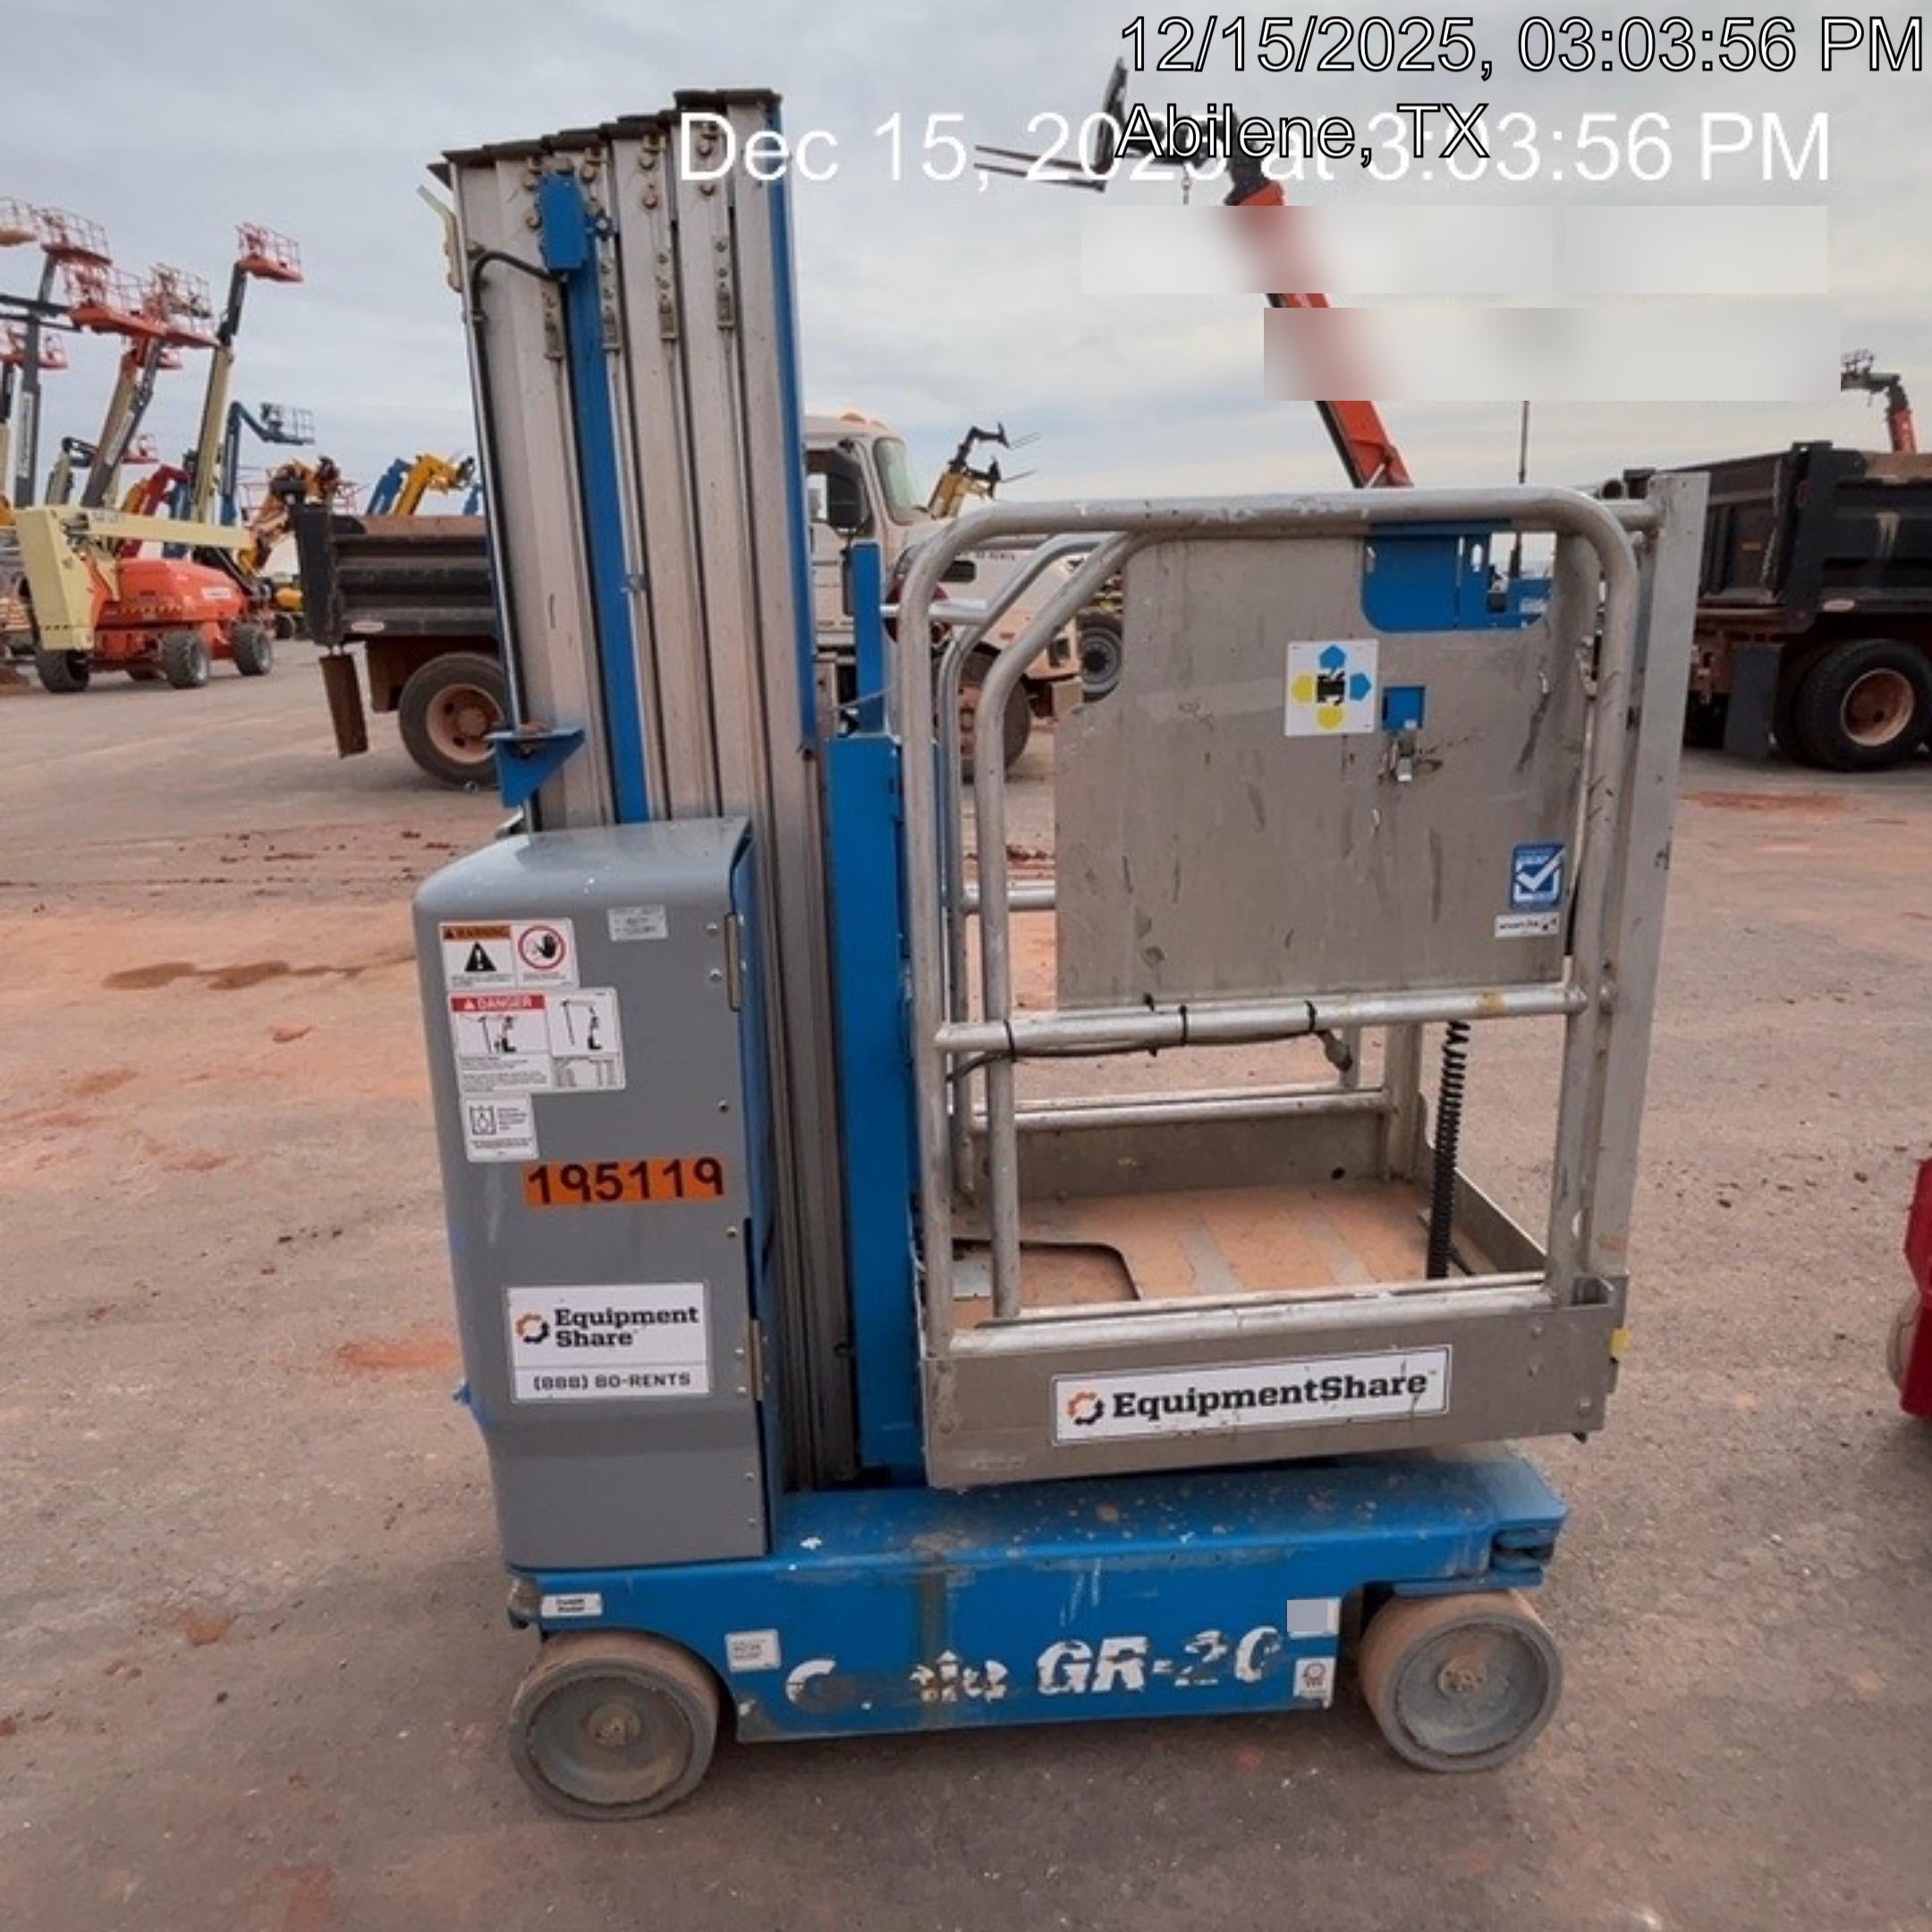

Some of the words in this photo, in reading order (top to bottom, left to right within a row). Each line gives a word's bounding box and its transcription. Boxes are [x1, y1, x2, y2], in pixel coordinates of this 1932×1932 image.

[478, 994, 532, 1010] DANGER
[528, 1157, 724, 1204] 195119
[555, 1307, 699, 1328] Equipment
[555, 1330, 633, 1348] Share
[533, 1374, 589, 1391] (888)
[1114, 1373, 1428, 1420] EquipmentShare
